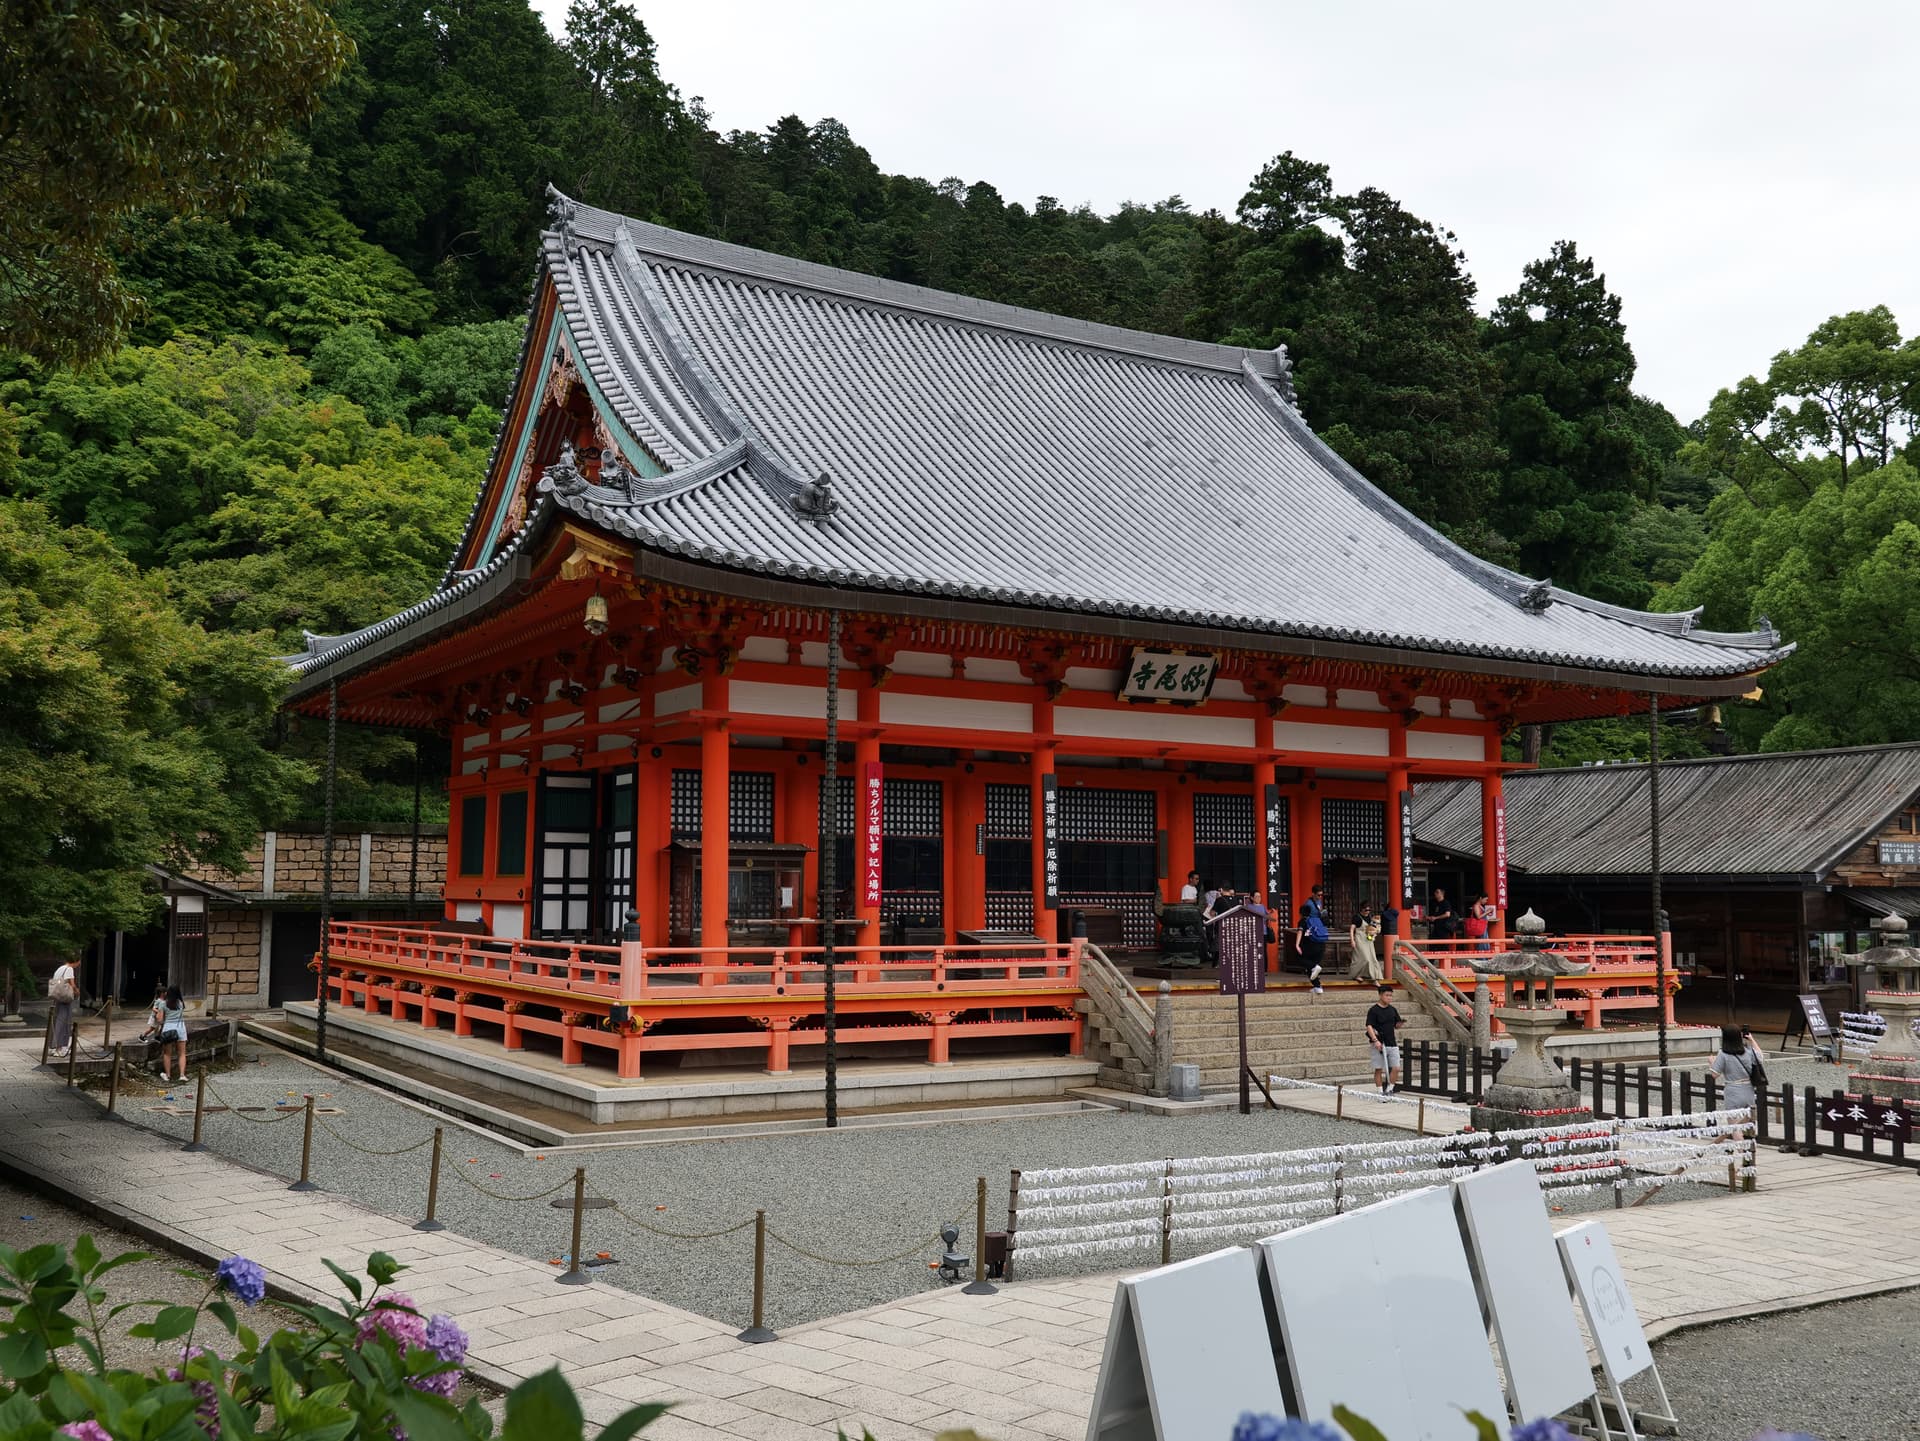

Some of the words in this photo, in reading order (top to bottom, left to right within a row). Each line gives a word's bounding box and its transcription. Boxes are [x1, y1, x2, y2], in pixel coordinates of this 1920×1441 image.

[868, 778, 881, 853] 勝ちダルマ願い事
[1045, 790, 1058, 897] 勝運祈願・厄除祈願
[1266, 809, 1277, 893] 勝尾寺本堂
[867, 857, 880, 901] 記入場所
[1846, 1104, 1903, 1128] 本堂
